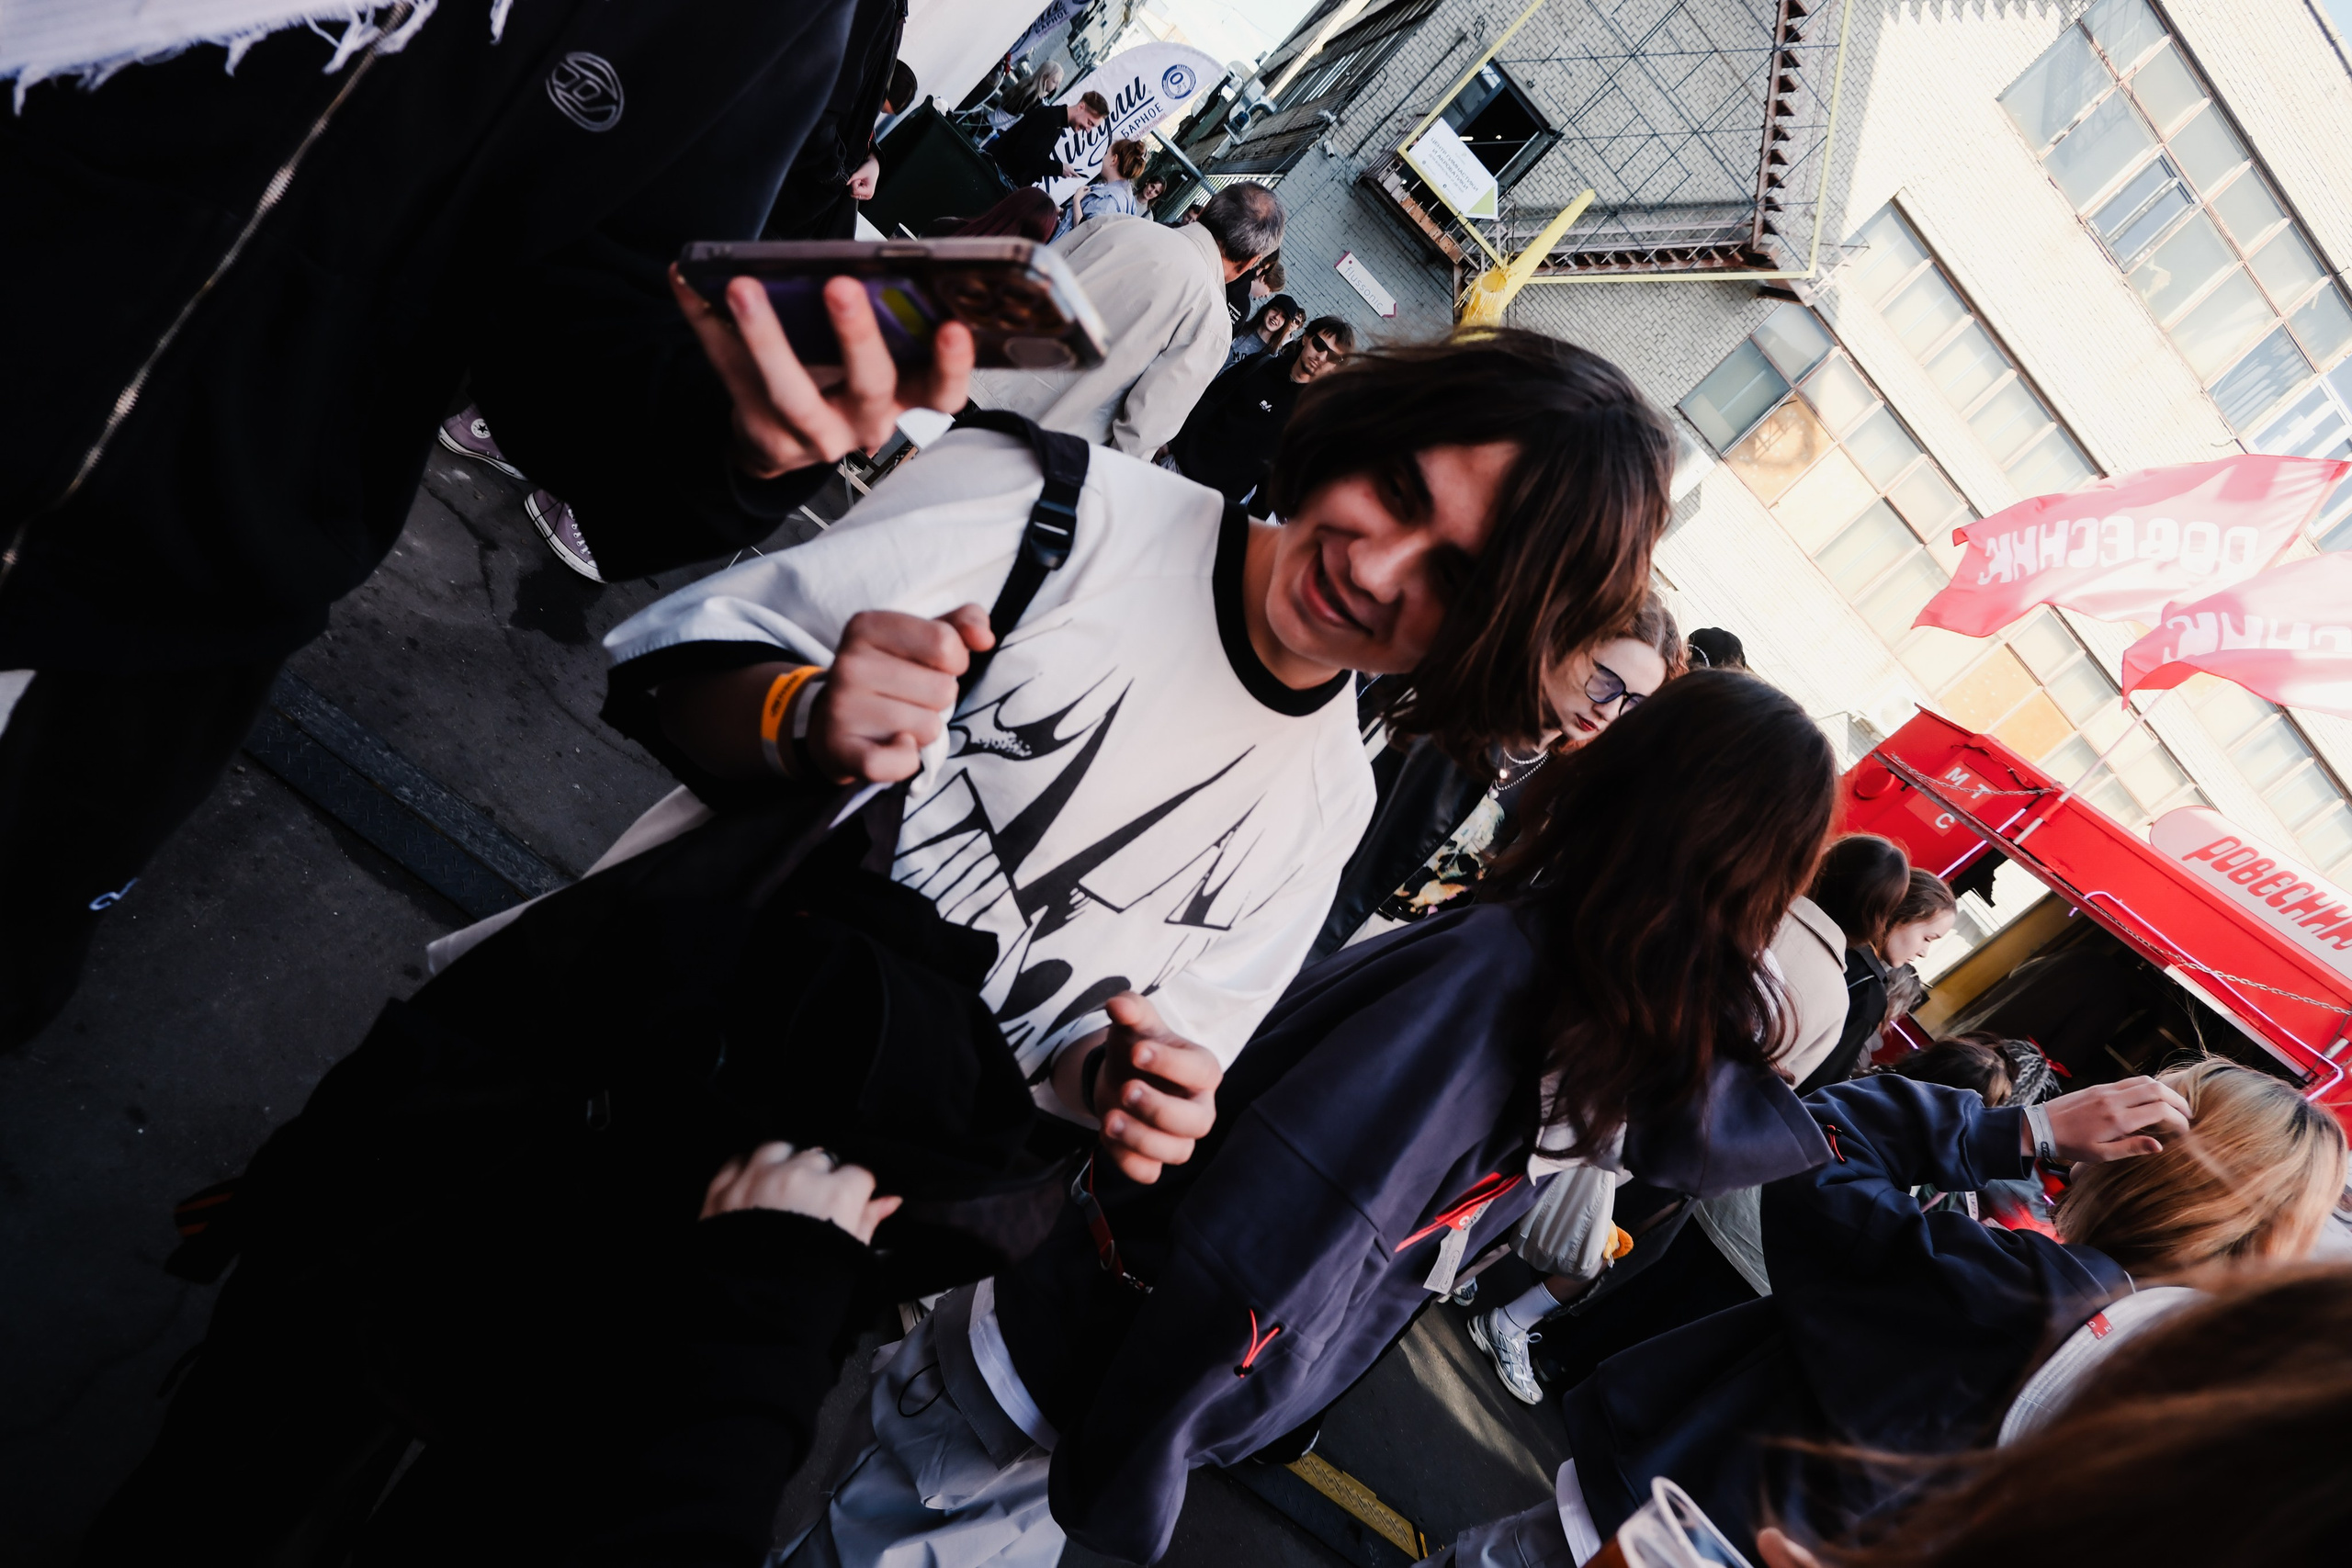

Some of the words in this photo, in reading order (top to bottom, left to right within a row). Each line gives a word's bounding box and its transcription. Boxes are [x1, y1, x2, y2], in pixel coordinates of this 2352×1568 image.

[1120, 102, 1163, 139] БАРНОЕ
[1131, 112, 1169, 140] ЗАЛКОГОЛЬНОЕ
[1430, 137, 1447, 155] ЦЕНТР
[1445, 154, 1479, 192] ГИМНАСТИКИ
[1438, 154, 1469, 190] АКРОБАТИКИ
[1345, 266, 1384, 310] flussonic
